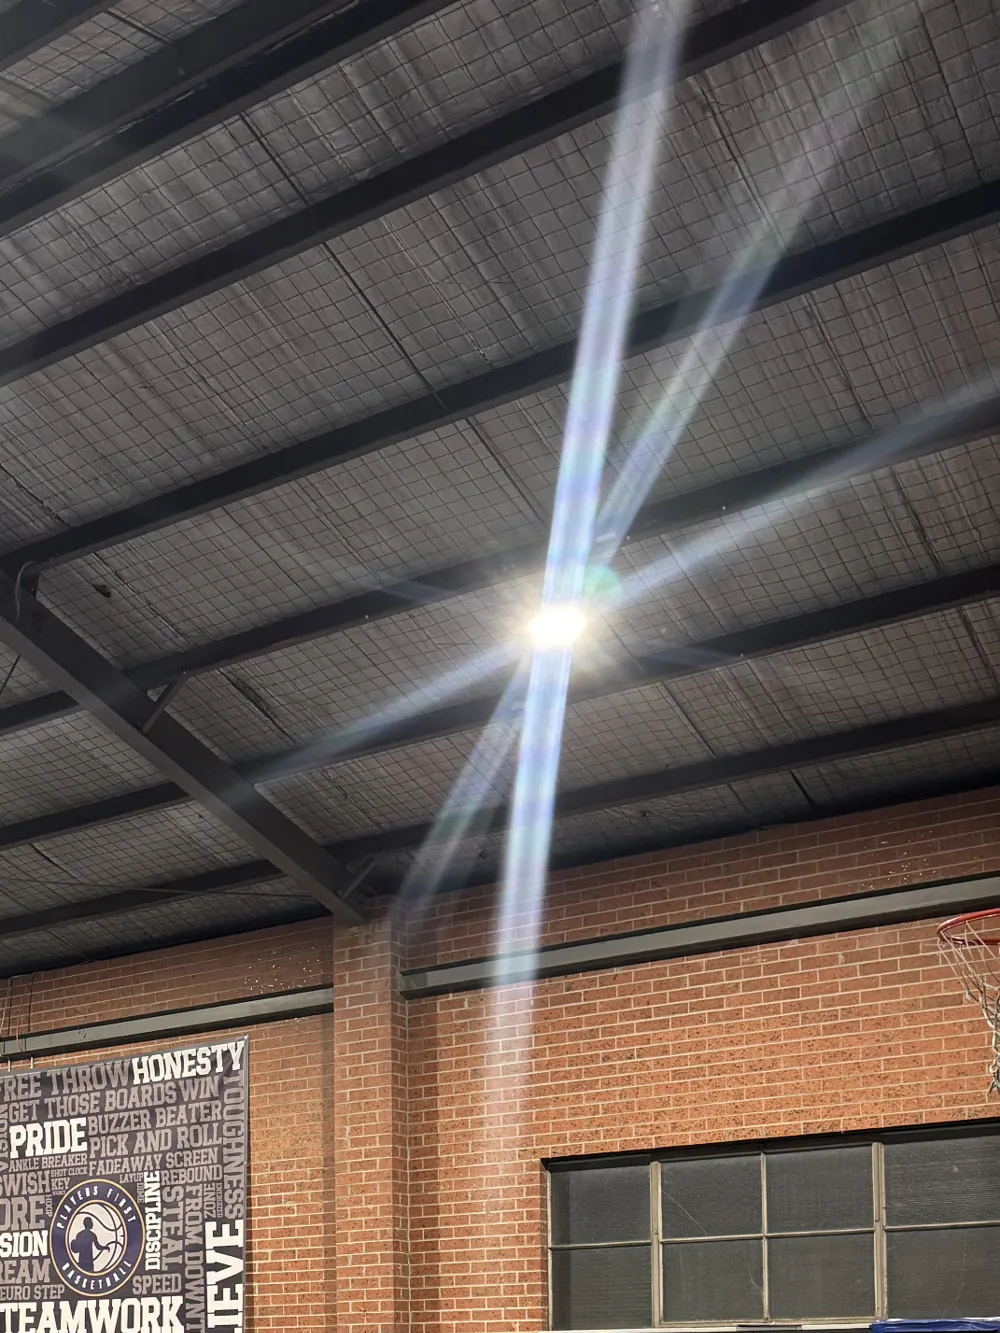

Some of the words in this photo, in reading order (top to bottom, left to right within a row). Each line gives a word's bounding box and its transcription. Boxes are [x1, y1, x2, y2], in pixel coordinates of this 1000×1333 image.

[47, 1059, 131, 1095] THROW
[131, 1041, 244, 1084] HONESTY
[9, 1100, 40, 1123] GET
[44, 1092, 100, 1119] THOSE
[104, 1081, 176, 1112] BOARDS
[179, 1075, 219, 1102] WIN
[88, 1109, 151, 1136] BUZZER
[155, 1100, 222, 1128] BEATER
[9, 1117, 88, 1159] PRIDE
[90, 1133, 129, 1159] PICK
[133, 1128, 172, 1154] AND
[176, 1122, 223, 1149] ROLL
[223, 1070, 245, 1219] TOUGHNESS
[9, 1158, 40, 1173] ANKLE
[41, 1152, 88, 1169] BREAKER
[51, 1168, 67, 1178] SHOT
[68, 1166, 88, 1176] CLOCK
[89, 1152, 162, 1176] FADEAWAY
[166, 1147, 218, 1169] SCREEN
[51, 1176, 70, 1191] KEY
[119, 1172, 143, 1184] LAYUP
[161, 1164, 222, 1185] REBOUND
[45, 1194, 53, 1217] HOOP
[56, 1185, 98, 1229] PLAYERS
[106, 1188, 136, 1222] FIRST
[185, 1184, 203, 1246] FROM
[203, 1182, 216, 1219] ZONE
[144, 1170, 161, 1271] DISCIPLINE
[162, 1185, 184, 1271] STEAL
[61, 1261, 132, 1290] BASKETBALL
[132, 1273, 182, 1295] SPEED
[0, 1285, 31, 1300] EURO
[34, 1284, 65, 1300] STEP
